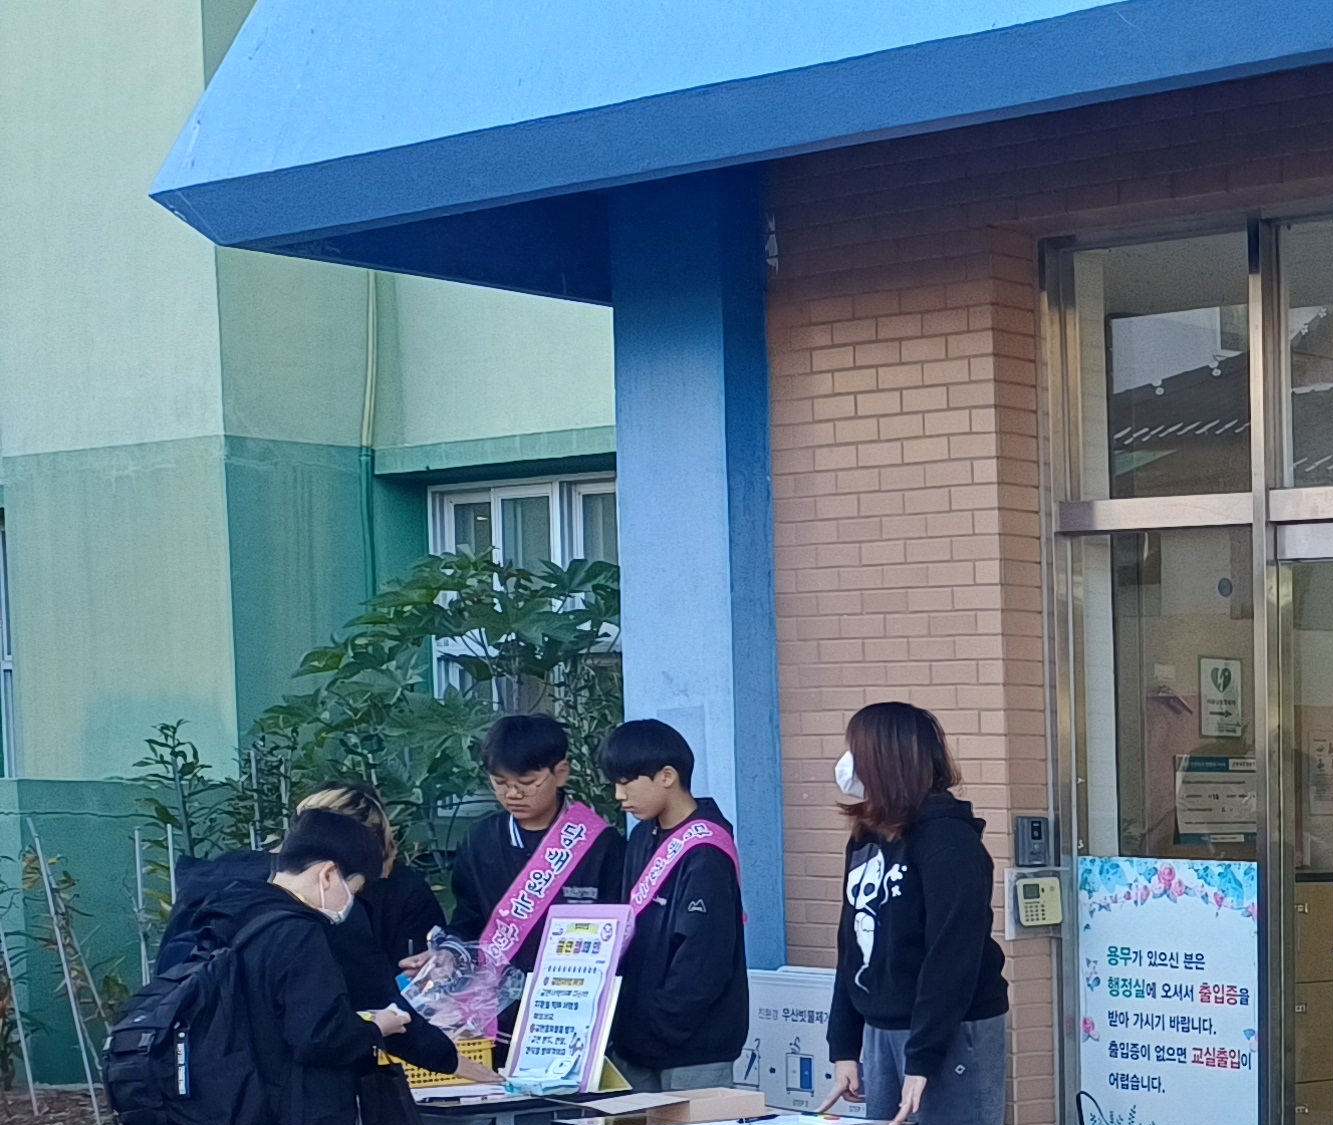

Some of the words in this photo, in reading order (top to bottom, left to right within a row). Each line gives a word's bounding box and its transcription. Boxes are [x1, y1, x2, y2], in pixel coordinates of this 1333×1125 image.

[1106, 945, 1144, 968] 용무가
[1147, 950, 1180, 970] 있으신
[1183, 952, 1206, 971] 분은
[1107, 976, 1157, 999] 행정실에
[1198, 982, 1250, 1007] 출입증을
[1108, 1010, 1129, 1029] 받아
[1133, 1012, 1166, 1032] 가시기
[1169, 1015, 1217, 1036] 바랍니다.
[1108, 1041, 1151, 1062] 출입증이
[1154, 1044, 1188, 1064] 없으면
[1191, 1046, 1252, 1071] 교실출입이
[1108, 1072, 1166, 1094] 어렵습니다.
